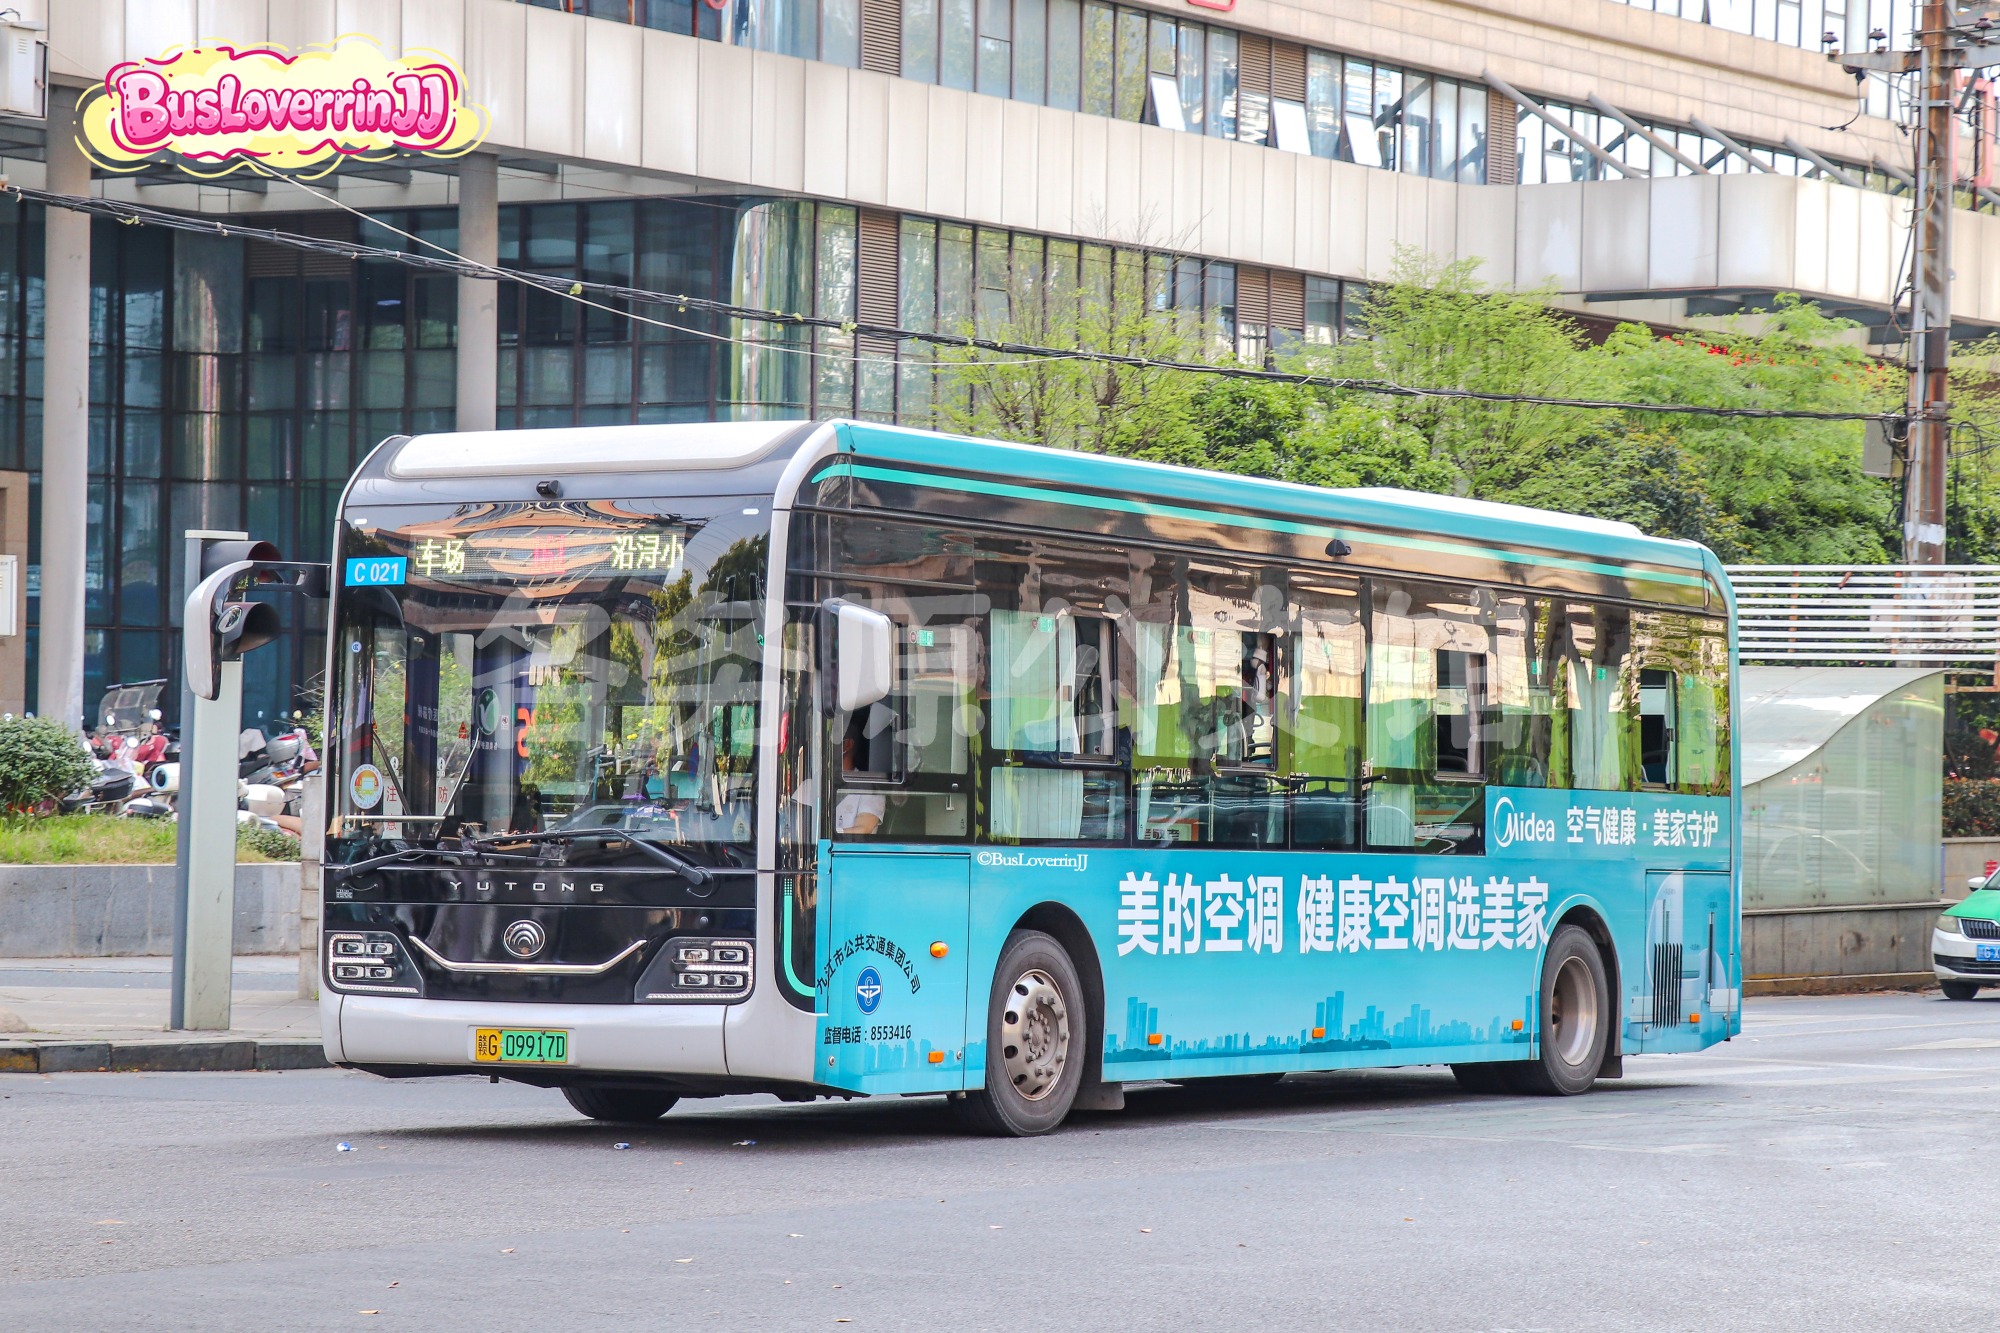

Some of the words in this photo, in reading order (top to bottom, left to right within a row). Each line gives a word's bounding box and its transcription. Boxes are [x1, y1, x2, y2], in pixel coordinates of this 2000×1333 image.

[354, 562, 366, 583] C
[370, 562, 399, 582] 021
[416, 539, 466, 576] 车场
[1494, 797, 1555, 847] Midea
[451, 881, 604, 892] YUTONG
[1117, 871, 1283, 957] 美的空调
[1297, 874, 1549, 953] 健康空调选美家
[816, 934, 921, 995] 九江市公共交通集团公司
